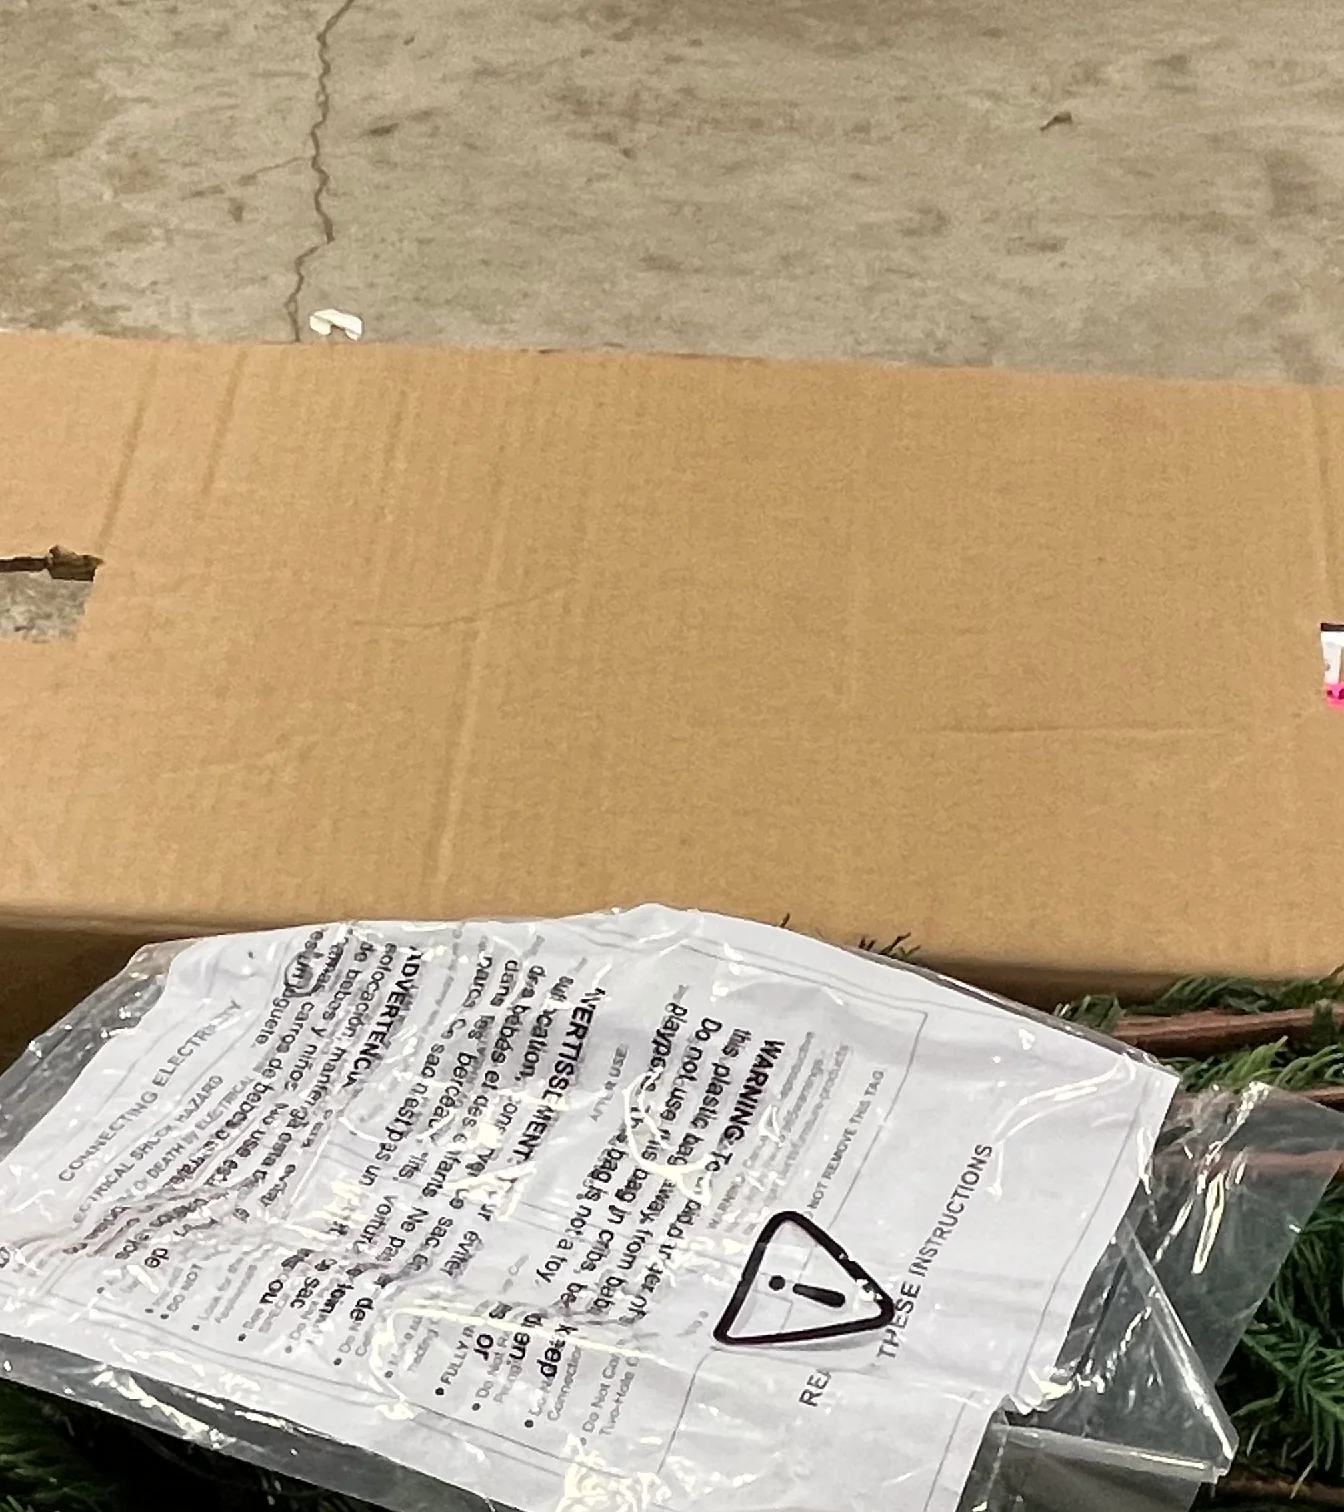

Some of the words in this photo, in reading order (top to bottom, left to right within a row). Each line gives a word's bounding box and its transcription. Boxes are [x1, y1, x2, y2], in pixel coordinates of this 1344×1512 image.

[488, 957, 522, 1009] dans
[694, 1016, 721, 1045] Do
[720, 1025, 751, 1061] this
[676, 1044, 706, 1084] not
[173, 1071, 224, 1125] HAZARD
[659, 1085, 687, 1123] use
[688, 1061, 734, 1134] plastic
[717, 1037, 784, 1151] WARNING:
[57, 1086, 159, 1185] CONNECTING
[373, 1125, 406, 1165] pas
[667, 1130, 702, 1171] bag
[807, 1181, 829, 1210] NOT
[821, 1126, 857, 1181] REMOVE
[863, 1067, 886, 1099] TAG
[146, 1140, 186, 1180] DEATH
[358, 1162, 382, 1189] un
[591, 1145, 626, 1187] bag
[616, 1165, 652, 1207] bag
[398, 1204, 429, 1237] Ne
[423, 1214, 453, 1251] sac
[556, 1236, 573, 1252] a
[617, 1226, 652, 1274] from
[875, 1279, 922, 1362] THESE
[908, 1140, 995, 1279] INSTRUCTIONS
[289, 1274, 320, 1312] sac
[438, 1339, 470, 1385] FULLY
